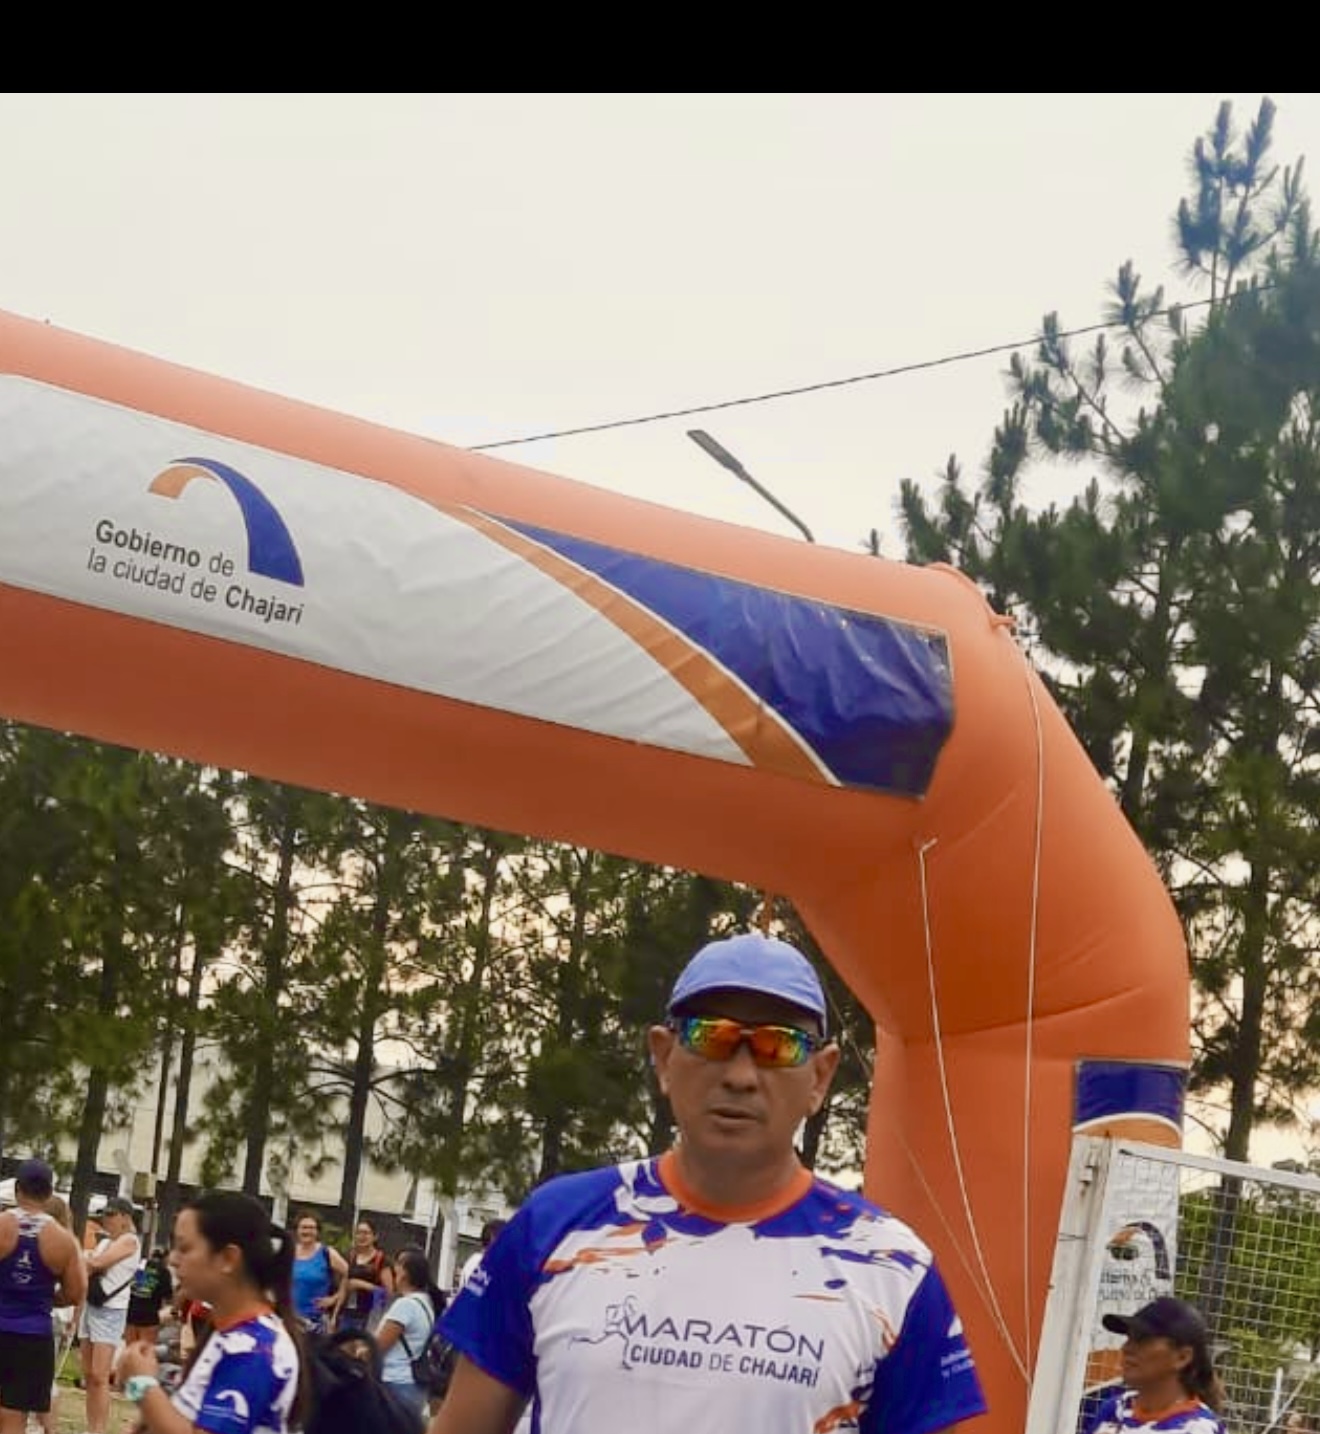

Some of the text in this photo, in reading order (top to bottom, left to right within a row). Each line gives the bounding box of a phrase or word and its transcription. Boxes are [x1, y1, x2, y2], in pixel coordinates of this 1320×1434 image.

[96, 519, 234, 577] Gobierno de
[87, 547, 106, 573] la
[113, 559, 185, 594] ciudad
[190, 578, 217, 602] de
[624, 1314, 824, 1361] MARATÓN
[630, 1344, 820, 1387] CIUDAD DE CHAJARÍ
